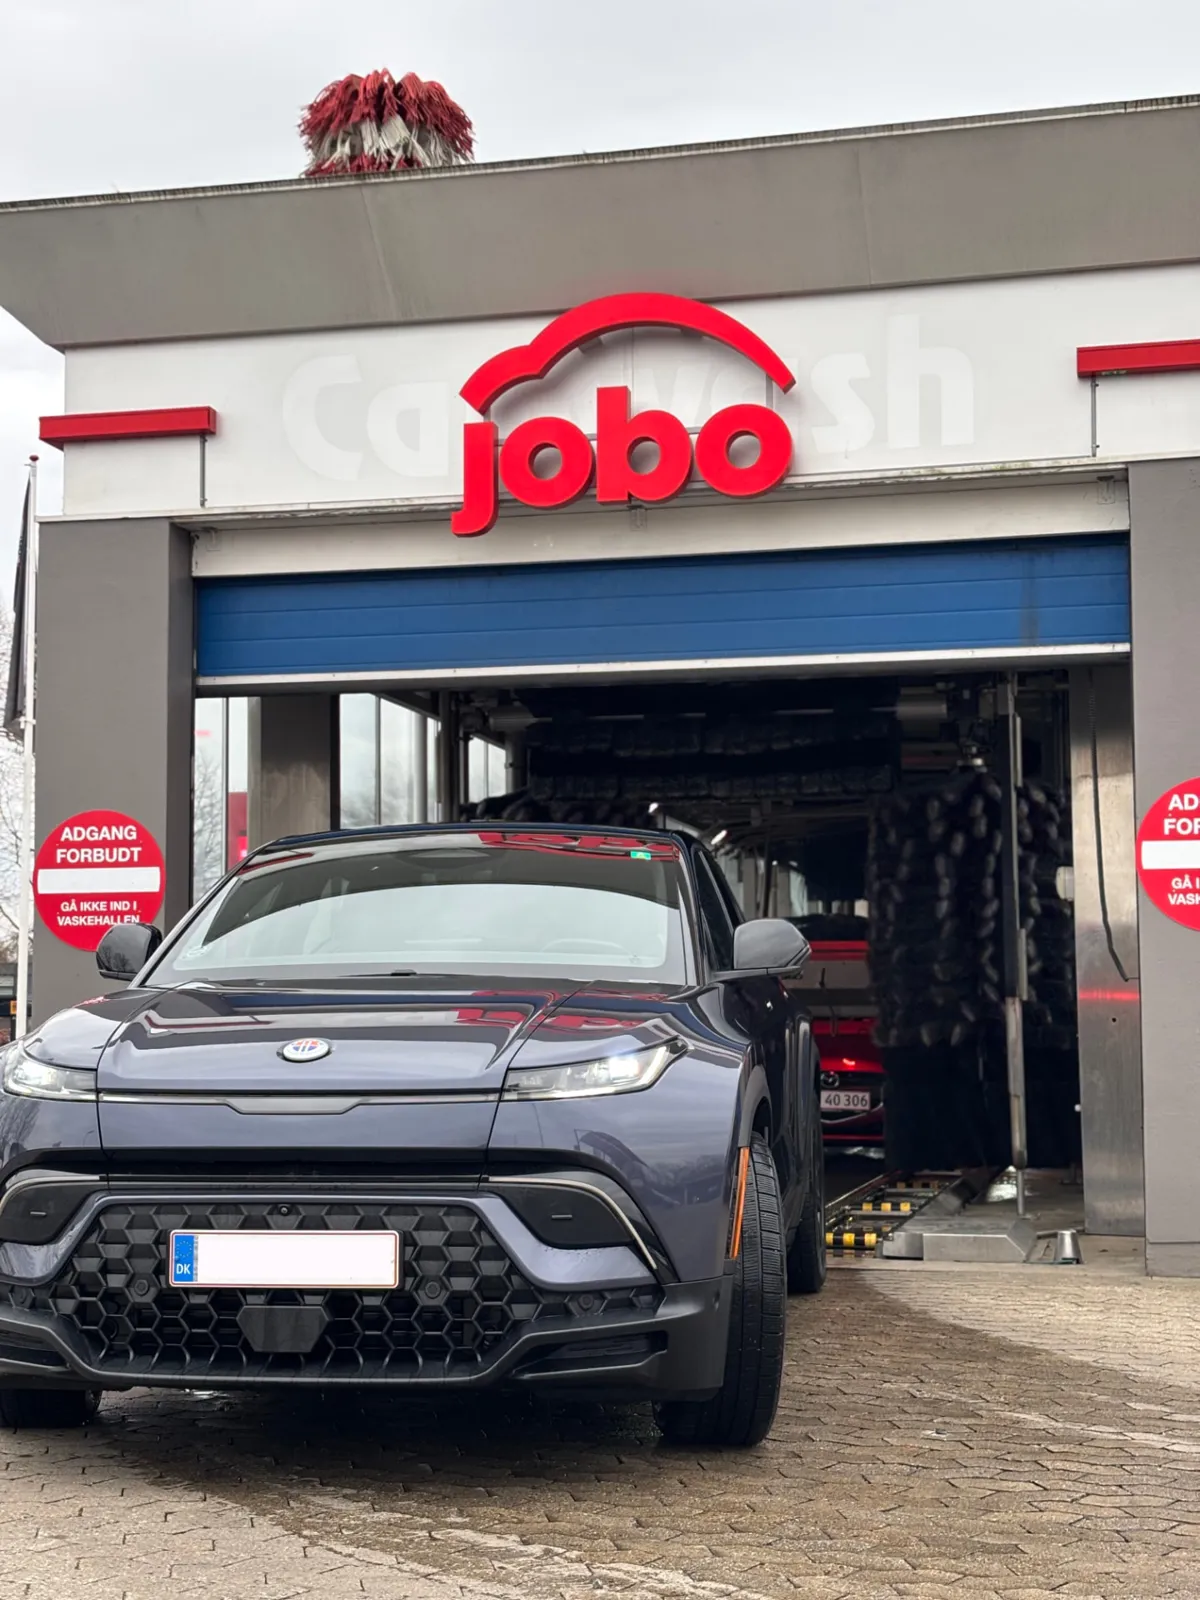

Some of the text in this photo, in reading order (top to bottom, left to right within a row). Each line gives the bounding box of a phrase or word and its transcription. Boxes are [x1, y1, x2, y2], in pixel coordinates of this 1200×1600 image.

[452, 386, 791, 537] jobo
[1168, 793, 1200, 811] AD
[60, 825, 137, 841] ADGANG
[56, 847, 142, 863] FORBUDT
[1171, 874, 1193, 889] GÅ
[60, 899, 137, 912] GÅ IKKE IND I
[1168, 892, 1200, 906] VAS
[57, 914, 140, 926] VASKEHALLEN
[825, 1094, 868, 1107] 40 306
[176, 1263, 191, 1275] DK
